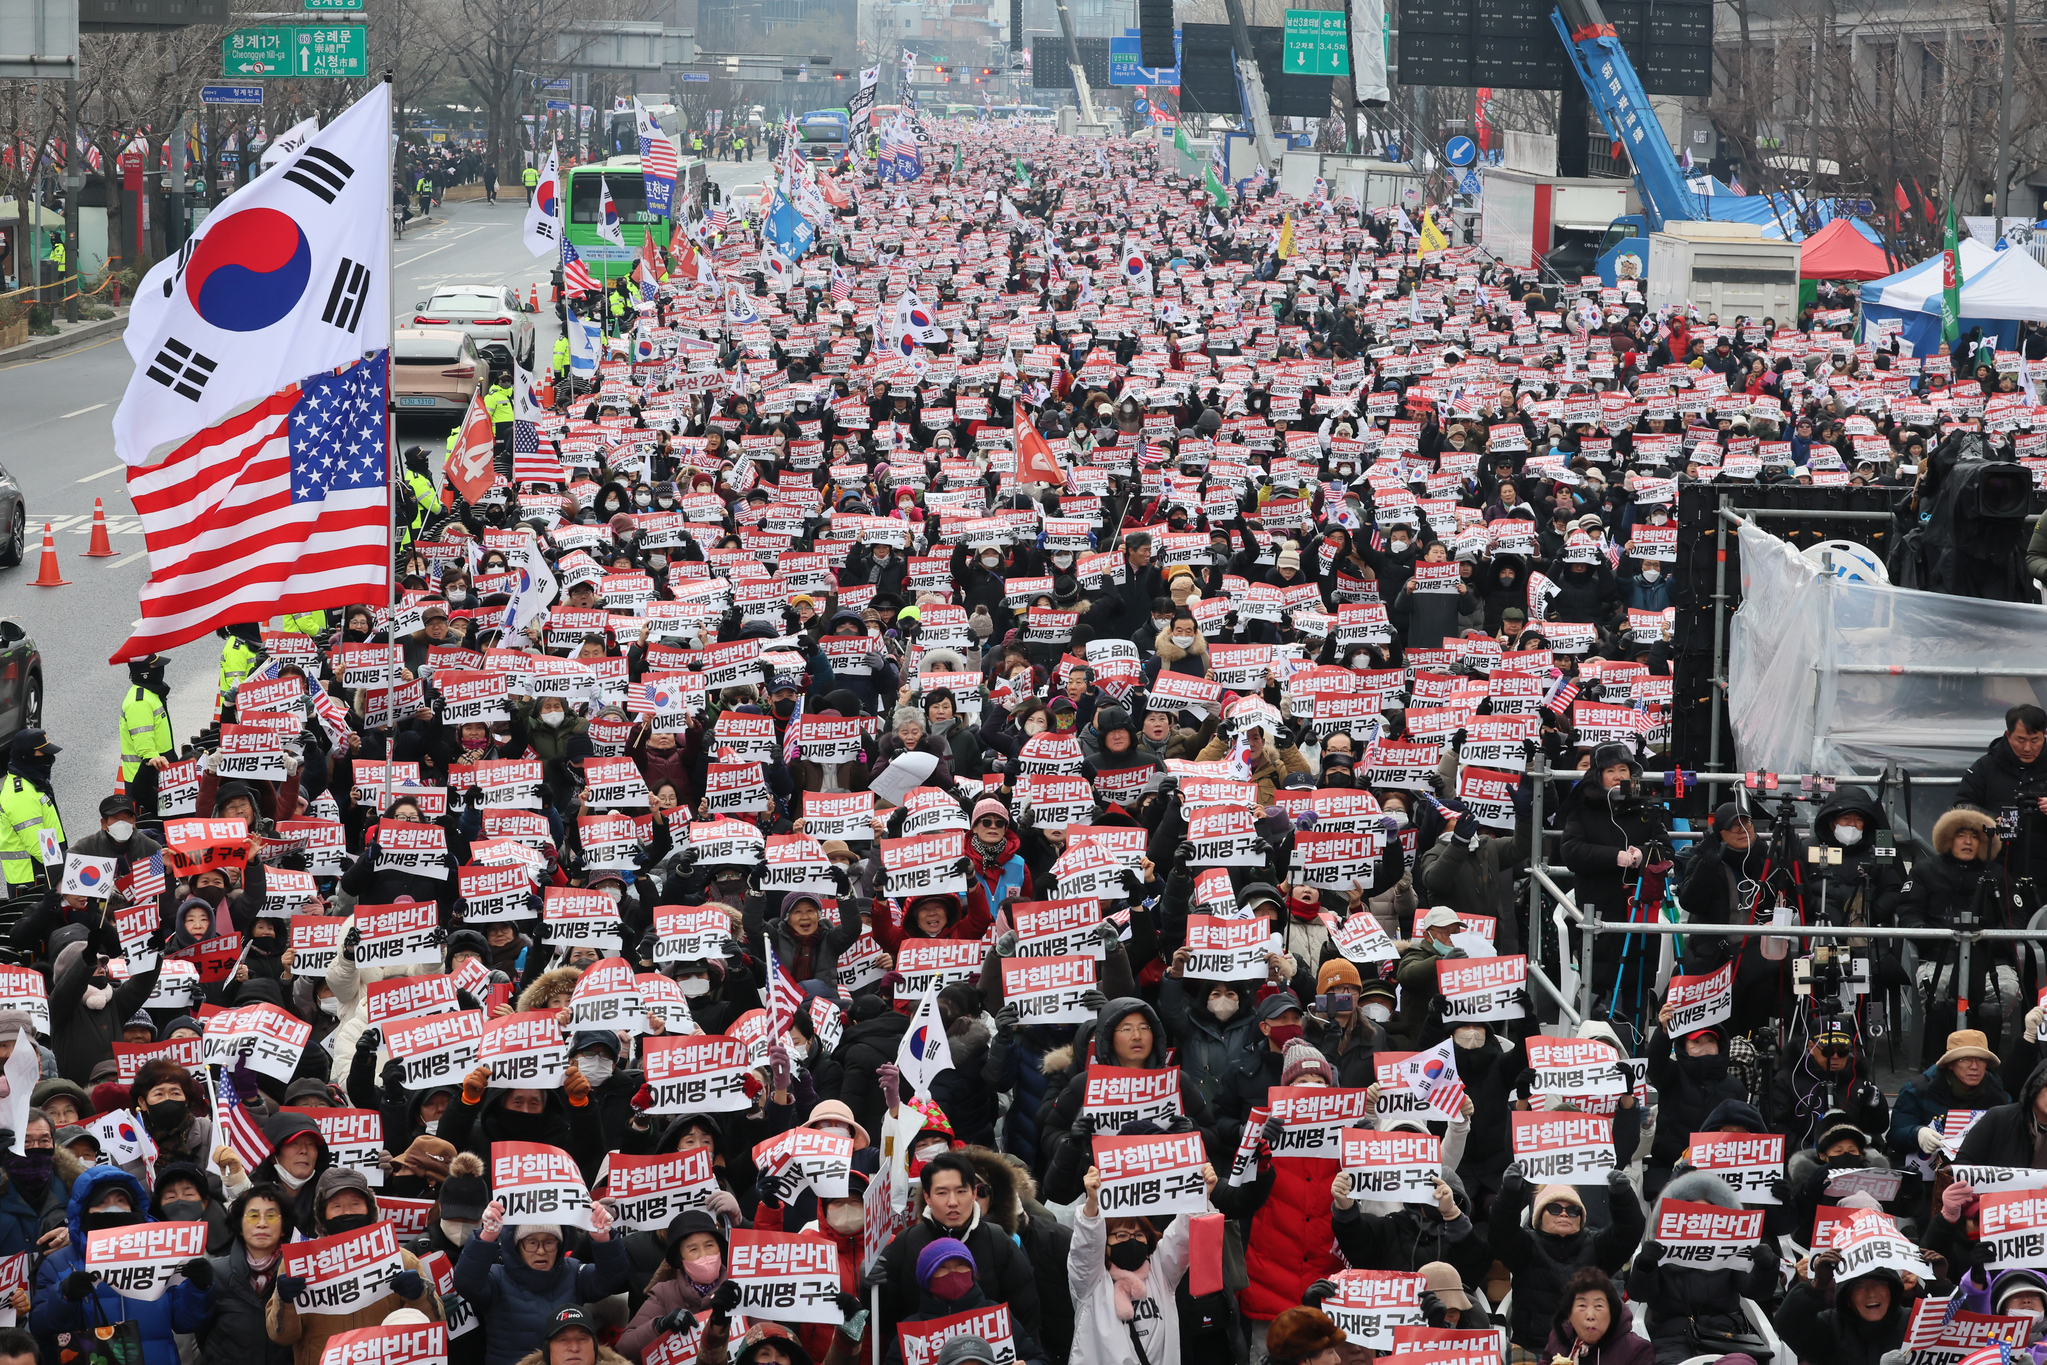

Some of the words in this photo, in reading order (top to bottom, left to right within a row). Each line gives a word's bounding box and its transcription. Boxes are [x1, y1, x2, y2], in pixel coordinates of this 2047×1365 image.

[1287, 18, 1318, 27] 남산3호터널
[232, 35, 280, 49] 청계1가
[313, 30, 352, 43] 숭례문
[232, 50, 265, 60] Cheonggye
[314, 55, 338, 68] 시청
[314, 68, 328, 76] City
[233, 88, 260, 96] 청계천로
[824, 355, 850, 363] 탄핵반대
[675, 377, 698, 391] 부산
[700, 373, 724, 388] 22A
[1519, 369, 1548, 378] 탄핵반대
[765, 391, 796, 399] 탄핵반대
[956, 398, 988, 408] 탄핵반대
[1270, 399, 1301, 408] 탄핵반대
[840, 406, 870, 416] 탄핵반대
[921, 410, 952, 419] 탄핵반대
[1144, 417, 1174, 426] 탄핵반대
[1490, 425, 1524, 437] 탄핵반대
[742, 438, 775, 448] 탄핵반대
[1331, 441, 1365, 451] 탄핵반대
[1759, 443, 1791, 455] 탄핵반대
[891, 452, 925, 462] 탄핵반대
[1092, 450, 1133, 461] 탄핵반대
[1724, 458, 1762, 466] 탄핵반대
[640, 517, 683, 531] 탄핵반대
[1046, 522, 1090, 534] 탄핵반대
[1163, 535, 1210, 548] 탄핵반대
[1633, 530, 1677, 543] 탄핵반대
[779, 556, 828, 572] 탄핵반대
[1415, 563, 1461, 578] 탄핵반대
[603, 578, 653, 592] 탄핵반대
[736, 582, 787, 600] 탄핵반대
[1006, 578, 1053, 593] 탄핵반대
[1414, 579, 1440, 591] 이재명
[553, 612, 608, 627] 탄핵반대
[648, 605, 704, 617] 탄핵반대
[1028, 610, 1078, 628] 탄핵반대
[1338, 608, 1387, 624] 탄핵반대
[1024, 628, 1054, 641] 이재명
[1543, 625, 1593, 637] 탄핵반대
[702, 643, 758, 668] 탄핵반대
[821, 639, 873, 654] 탄핵반대
[1211, 647, 1272, 667] 탄핵반대
[344, 669, 379, 684] 이재명
[704, 667, 736, 686] 이재명
[1213, 670, 1246, 684] 이재명
[1489, 674, 1542, 696] 탄핵반대
[442, 677, 506, 699] 탄핵반대
[1155, 678, 1221, 699] 탄핵반대
[444, 702, 480, 719] 이재명
[1317, 696, 1380, 716] 탄핵반대
[1575, 708, 1636, 725] 탄핵반대
[716, 718, 775, 736] 탄핵반대
[802, 718, 860, 738] 탄핵반대
[1466, 721, 1527, 742] 탄핵반대
[802, 743, 835, 756] 이재명
[1374, 747, 1437, 766] 탄핵반대
[1462, 746, 1500, 760] 이재명
[219, 756, 259, 772] 이재명
[476, 762, 542, 784] 탄핵반대
[1367, 768, 1405, 784] 이재명
[805, 794, 872, 814] 탄핵반대
[167, 823, 205, 846] 탄핵
[209, 820, 246, 840] 반대
[579, 818, 636, 842] 탄핵반대
[805, 819, 844, 835] 이재명
[378, 832, 446, 848] 탄핵반대
[173, 848, 212, 868] 이재명
[376, 852, 418, 869] 이재명
[883, 835, 963, 870] 탄핵반대
[886, 868, 931, 889] 이재명
[1341, 862, 1372, 878] 구속
[546, 897, 620, 918] 탄핵반대
[355, 904, 437, 936] 탄핵반대
[1017, 903, 1100, 938] 탄핵반대
[548, 923, 590, 939] 이재명
[1189, 922, 1268, 949] 탄핵반대
[356, 939, 404, 962] 이재명
[406, 932, 438, 953] 구속
[1187, 953, 1237, 972] 이재명
[1006, 960, 1094, 994] 탄핵반대
[1440, 960, 1525, 994] 탄핵반대
[1669, 967, 1731, 1004] 탄핵반대
[1010, 995, 1060, 1018] 이재명
[1444, 994, 1493, 1016] 이재명
[1668, 1005, 1706, 1030] 이재명
[207, 1008, 308, 1046] 탄핵반대
[388, 1013, 483, 1056] 탄핵반대
[204, 1034, 256, 1057] 이재명
[259, 1042, 299, 1068] 구속
[1530, 1044, 1618, 1068] 탄핵반대
[647, 1045, 746, 1078] 탄핵반대
[1532, 1067, 1583, 1089] 이재명
[1587, 1065, 1623, 1084] 구속
[652, 1080, 706, 1107] 이재명
[708, 1072, 745, 1096] 구속
[1088, 1071, 1178, 1103] 탄핵반대
[1516, 1119, 1612, 1151] 탄핵반대
[1098, 1136, 1201, 1180] 탄핵반대
[1345, 1138, 1438, 1165] 탄핵반대
[1691, 1137, 1782, 1168] 탄핵반대
[1519, 1155, 1574, 1178] 이재명
[1576, 1150, 1614, 1172] 구속
[609, 1152, 710, 1198] 탄핵반대
[1347, 1169, 1400, 1192] 이재명
[1100, 1182, 1161, 1210] 이재명
[1164, 1171, 1206, 1201] 구속
[610, 1196, 666, 1224] 이재명
[675, 1186, 712, 1214] 구속
[1661, 1212, 1762, 1241] 탄핵반대
[90, 1226, 206, 1262] 탄핵반대
[289, 1228, 396, 1286] 탄핵반대
[732, 1242, 838, 1278] 탄핵반대
[300, 1281, 360, 1309] 이재명
[736, 1283, 797, 1309] 이재명
[799, 1281, 840, 1304] 구속
[1335, 1275, 1426, 1306] 탄핵반대
